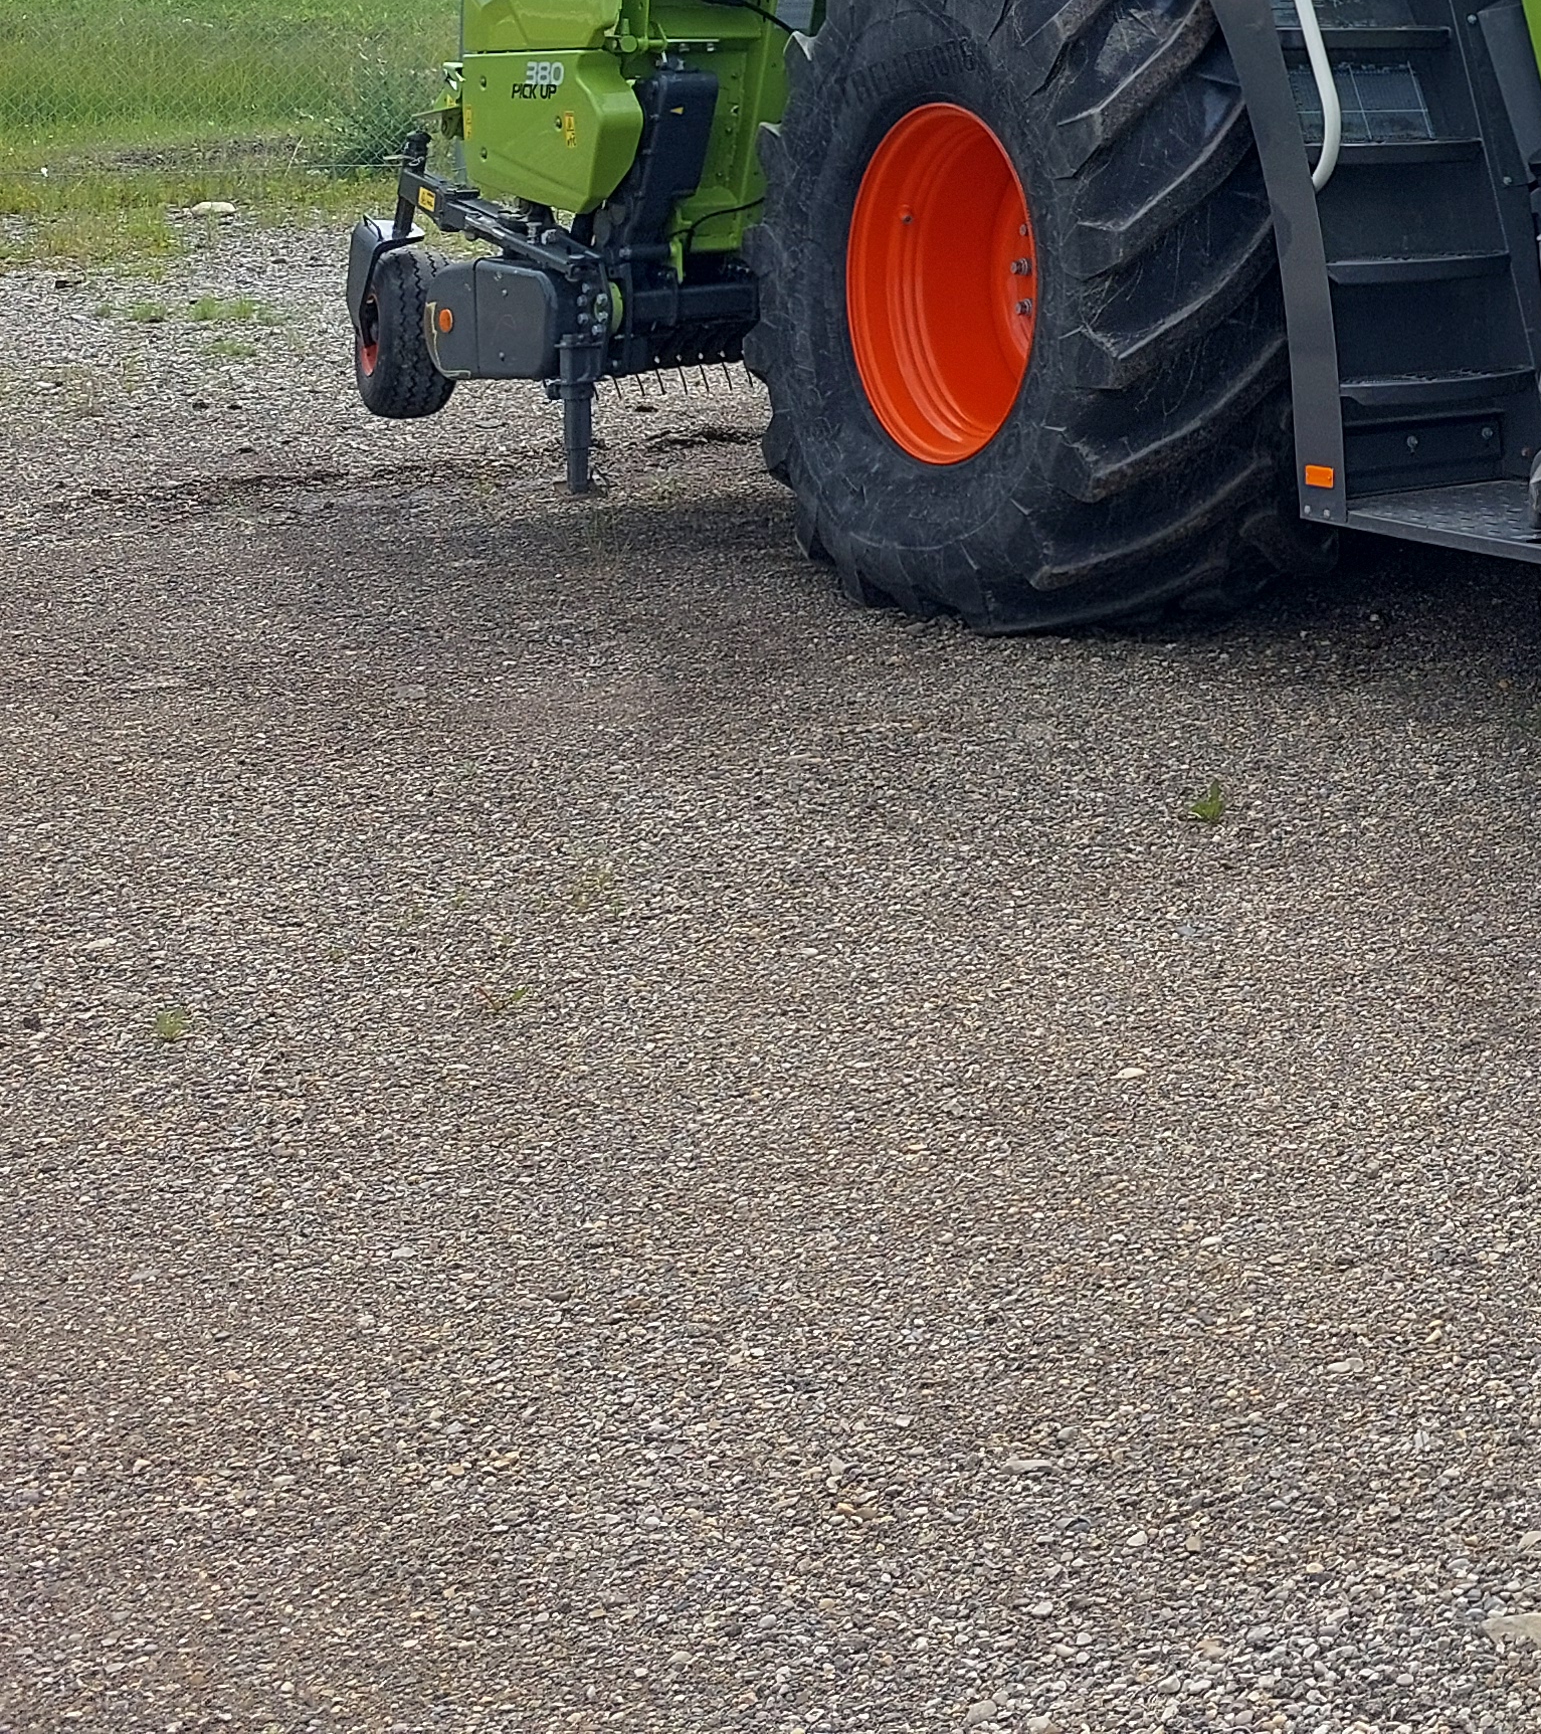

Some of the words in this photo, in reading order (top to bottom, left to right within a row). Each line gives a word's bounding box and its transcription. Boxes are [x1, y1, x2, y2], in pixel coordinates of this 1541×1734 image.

[525, 61, 564, 86] 380
[511, 83, 538, 99] PICK
[540, 83, 557, 99] UP
